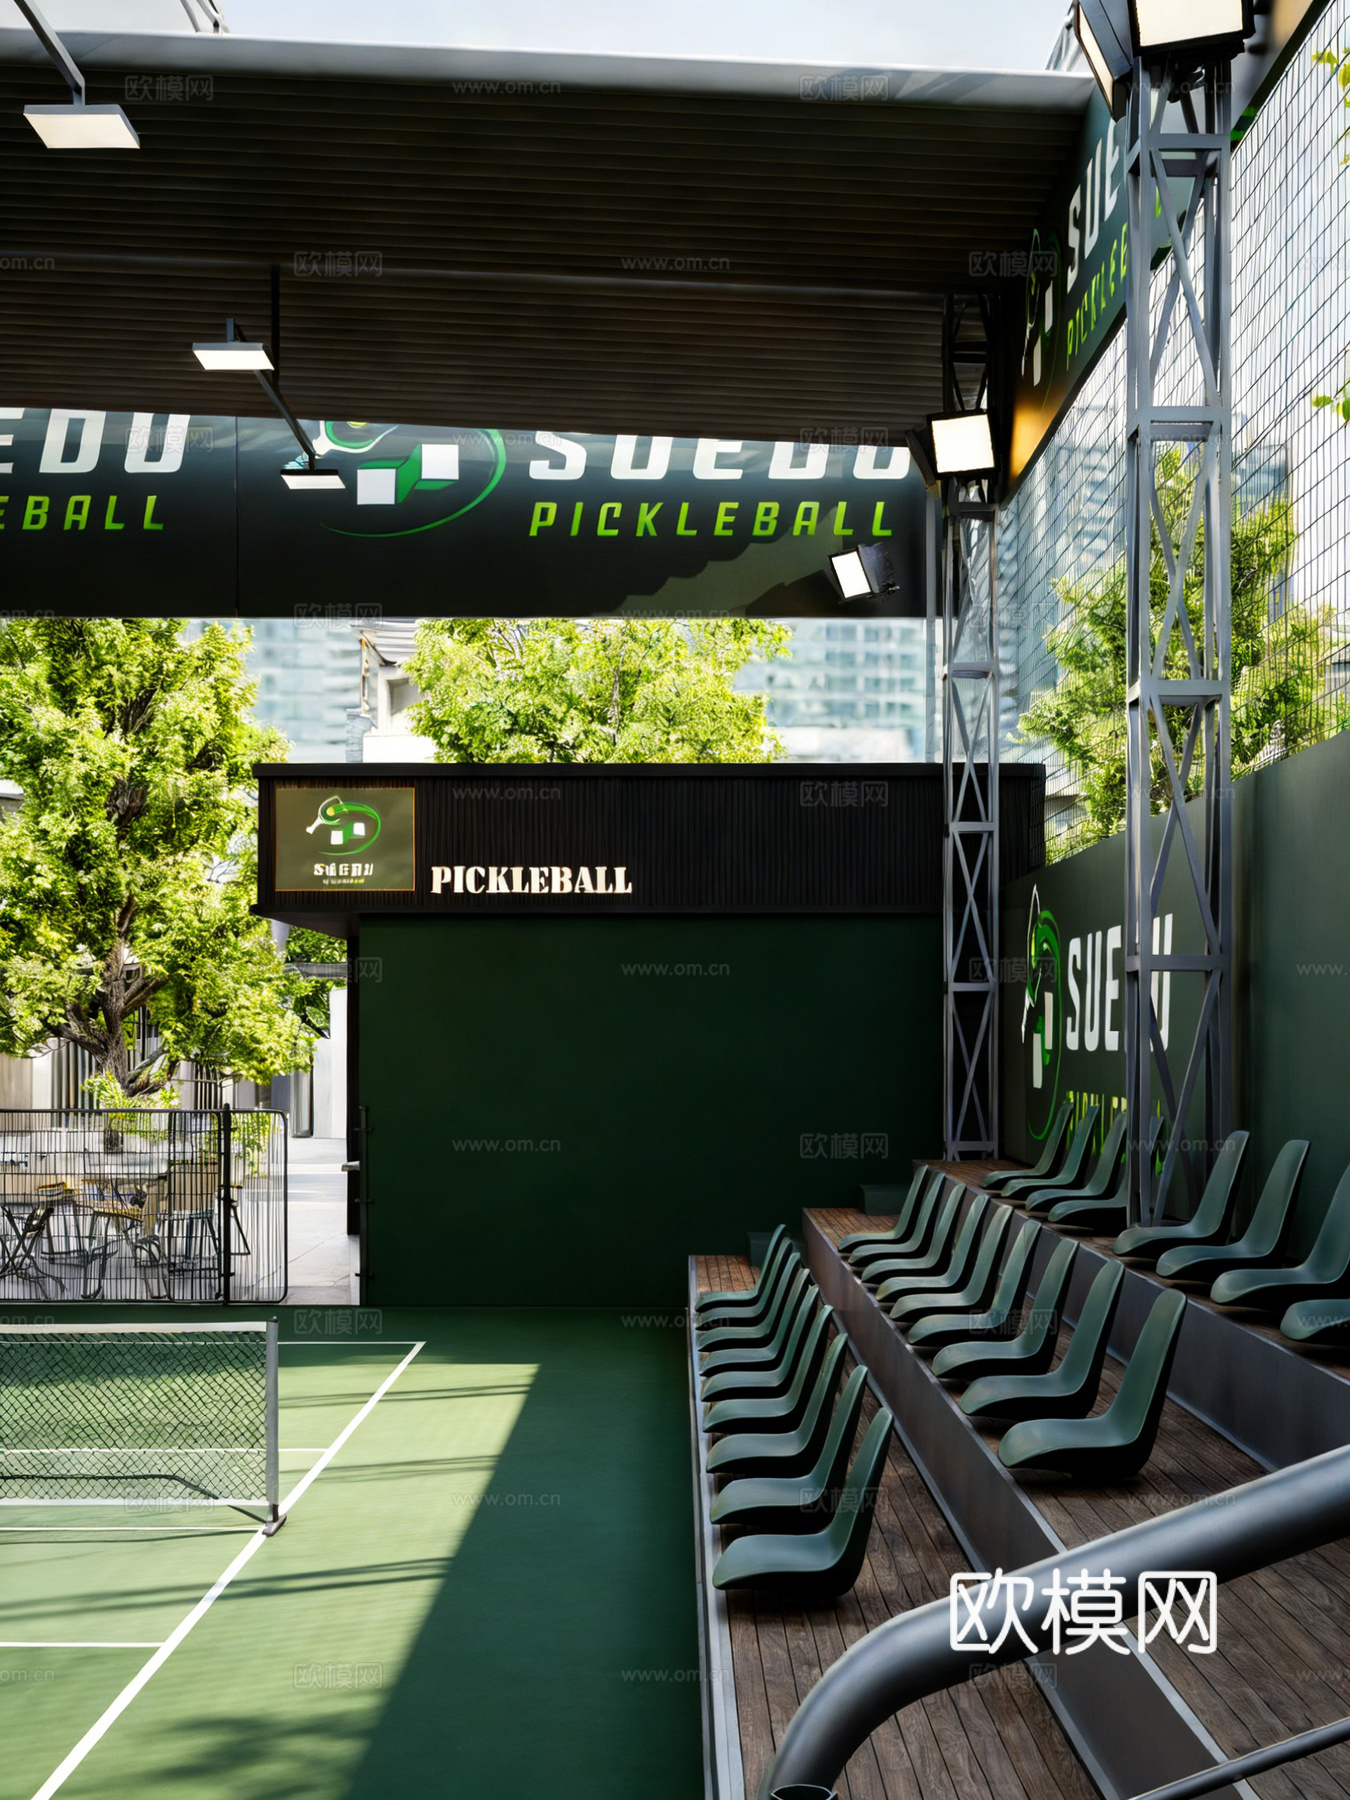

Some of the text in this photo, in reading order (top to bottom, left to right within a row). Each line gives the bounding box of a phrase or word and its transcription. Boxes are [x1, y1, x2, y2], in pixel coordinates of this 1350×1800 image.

[1066, 116, 1120, 294] SUE
[529, 501, 893, 537] PICKLEBALL
[430, 865, 633, 894] PICKLEBALL
[1066, 913, 1173, 1052] SUEU
